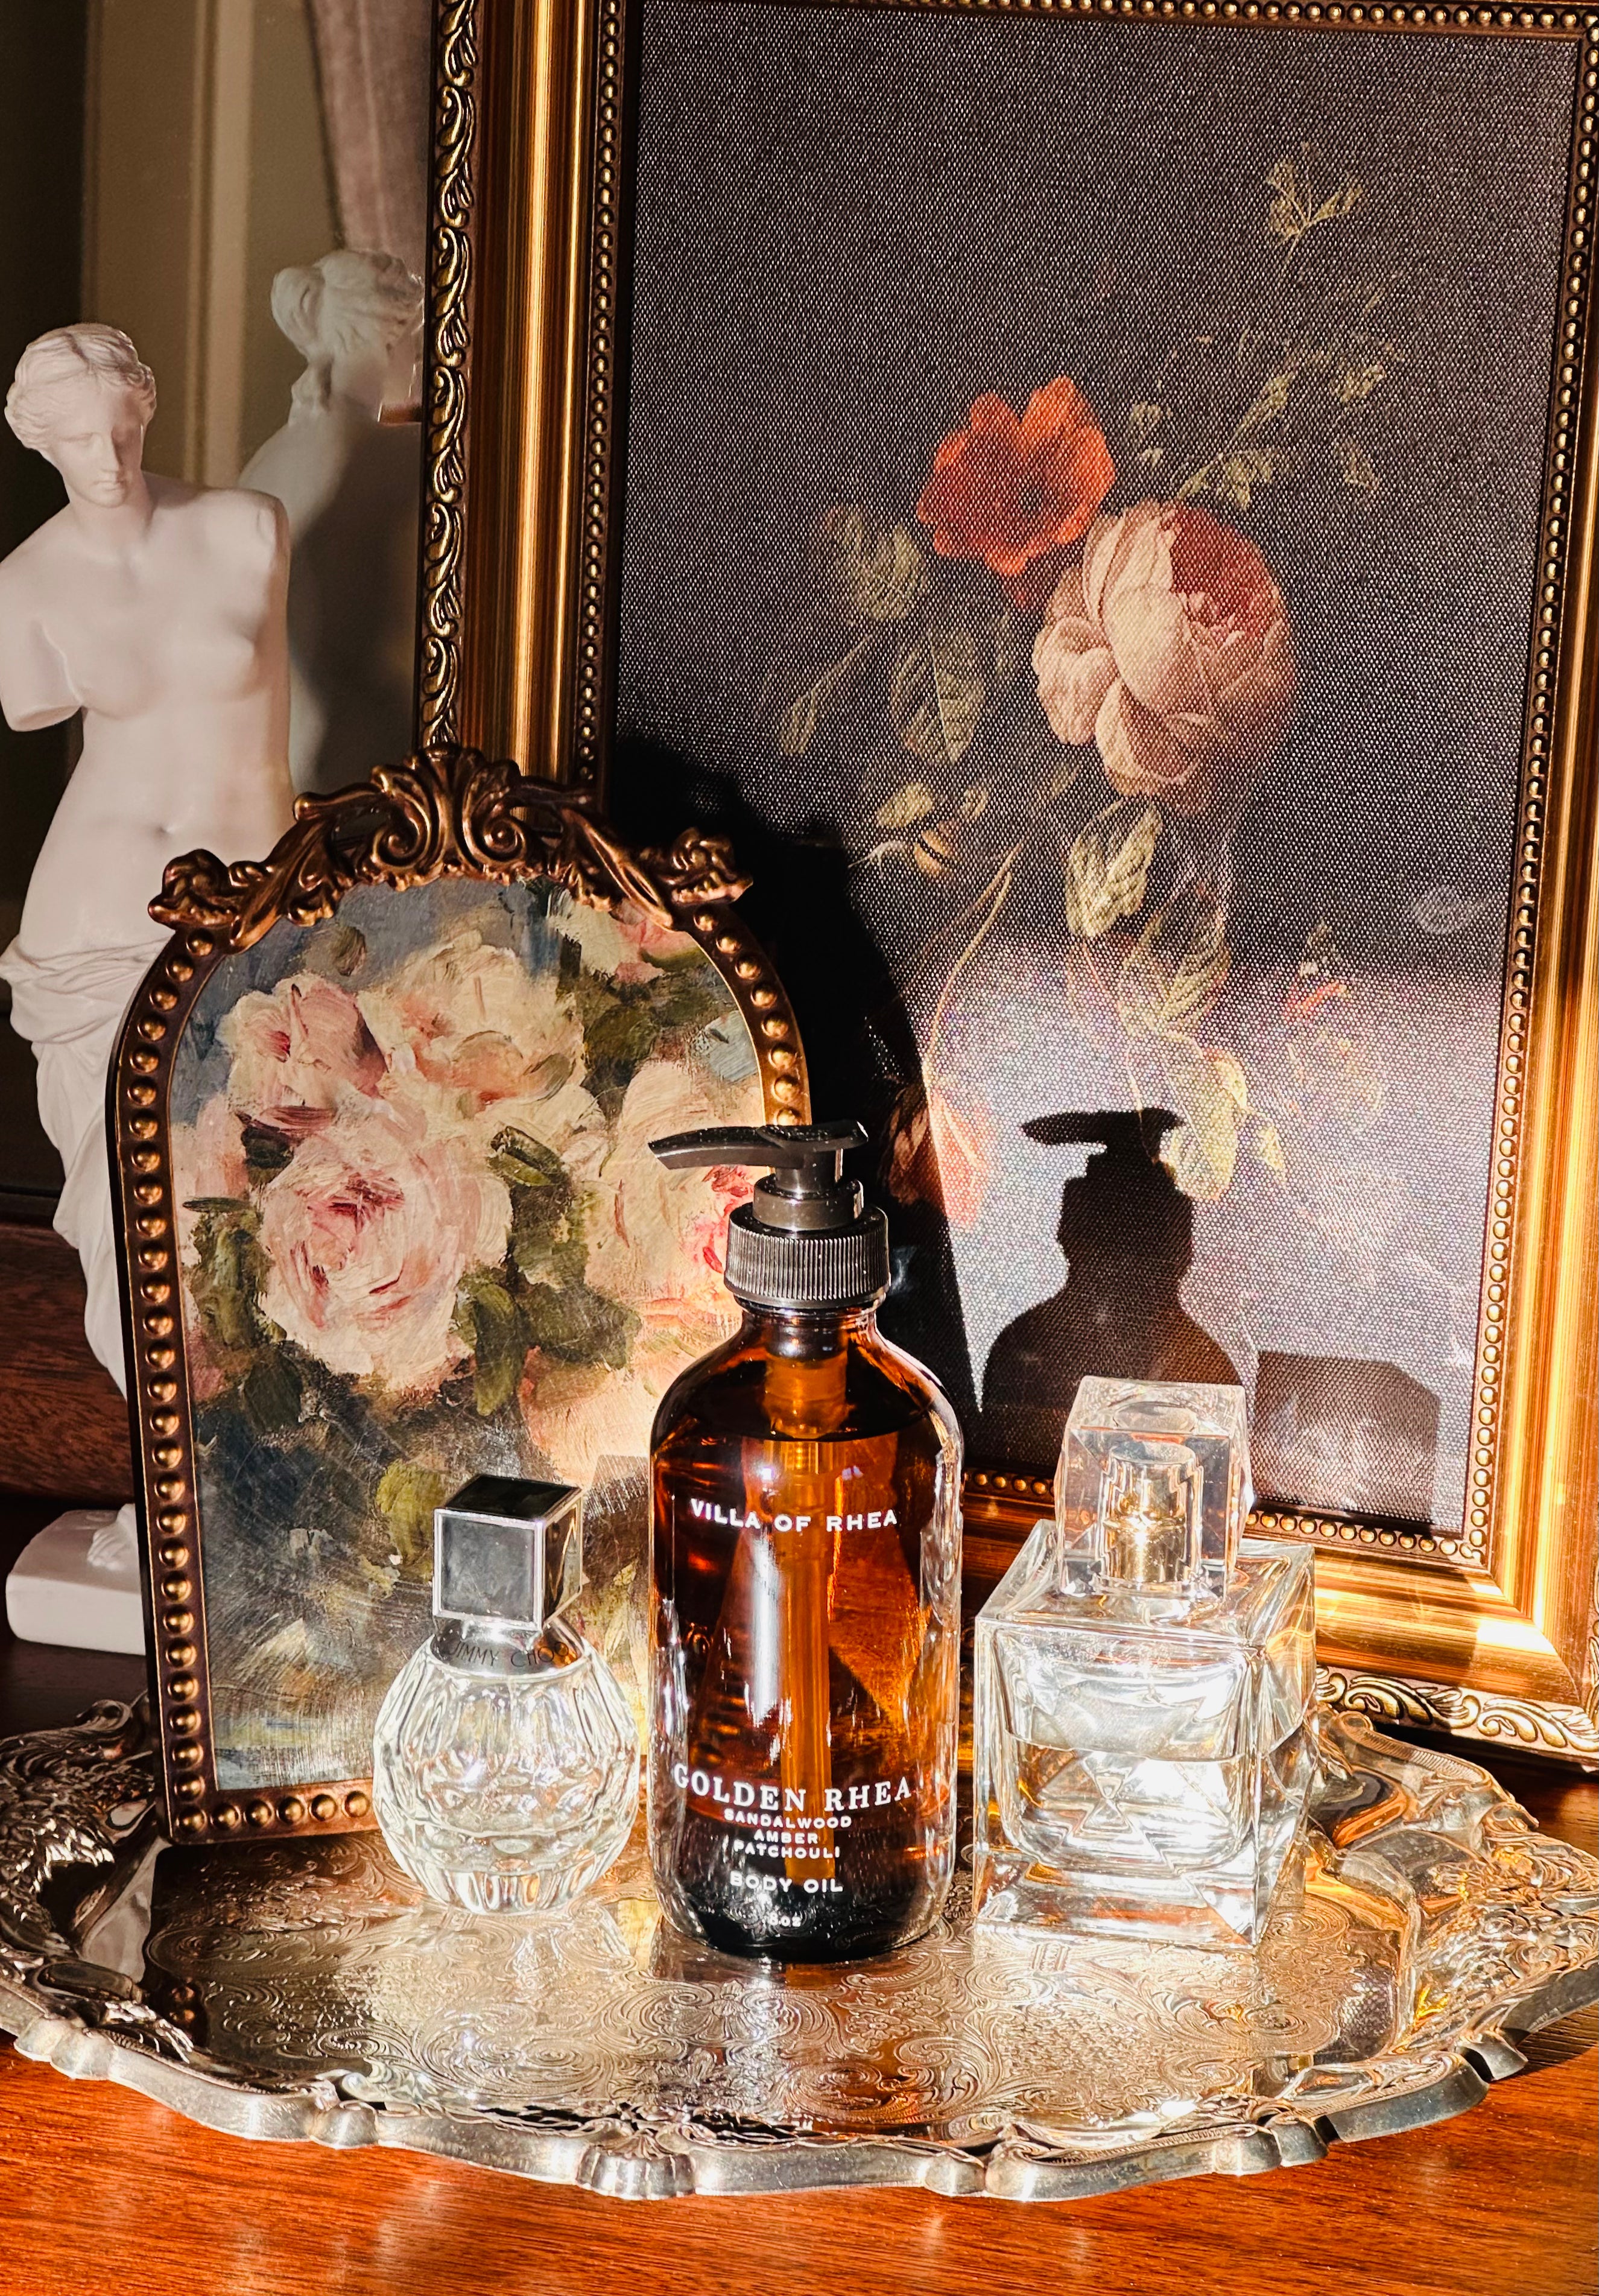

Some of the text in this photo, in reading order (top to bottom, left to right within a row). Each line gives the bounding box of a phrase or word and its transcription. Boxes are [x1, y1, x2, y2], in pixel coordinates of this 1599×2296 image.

[690, 1497, 898, 1532] VILLA OF RHEA
[447, 1641, 569, 1667] JIMMY CHOO
[673, 1762, 912, 1812] GOLDEN RHEA
[723, 1808, 852, 1829] SANDALWOOD
[753, 1828, 818, 1844] AMBER
[733, 1842, 841, 1859] PATCHOULI
[730, 1871, 844, 1893] BODY OIL
